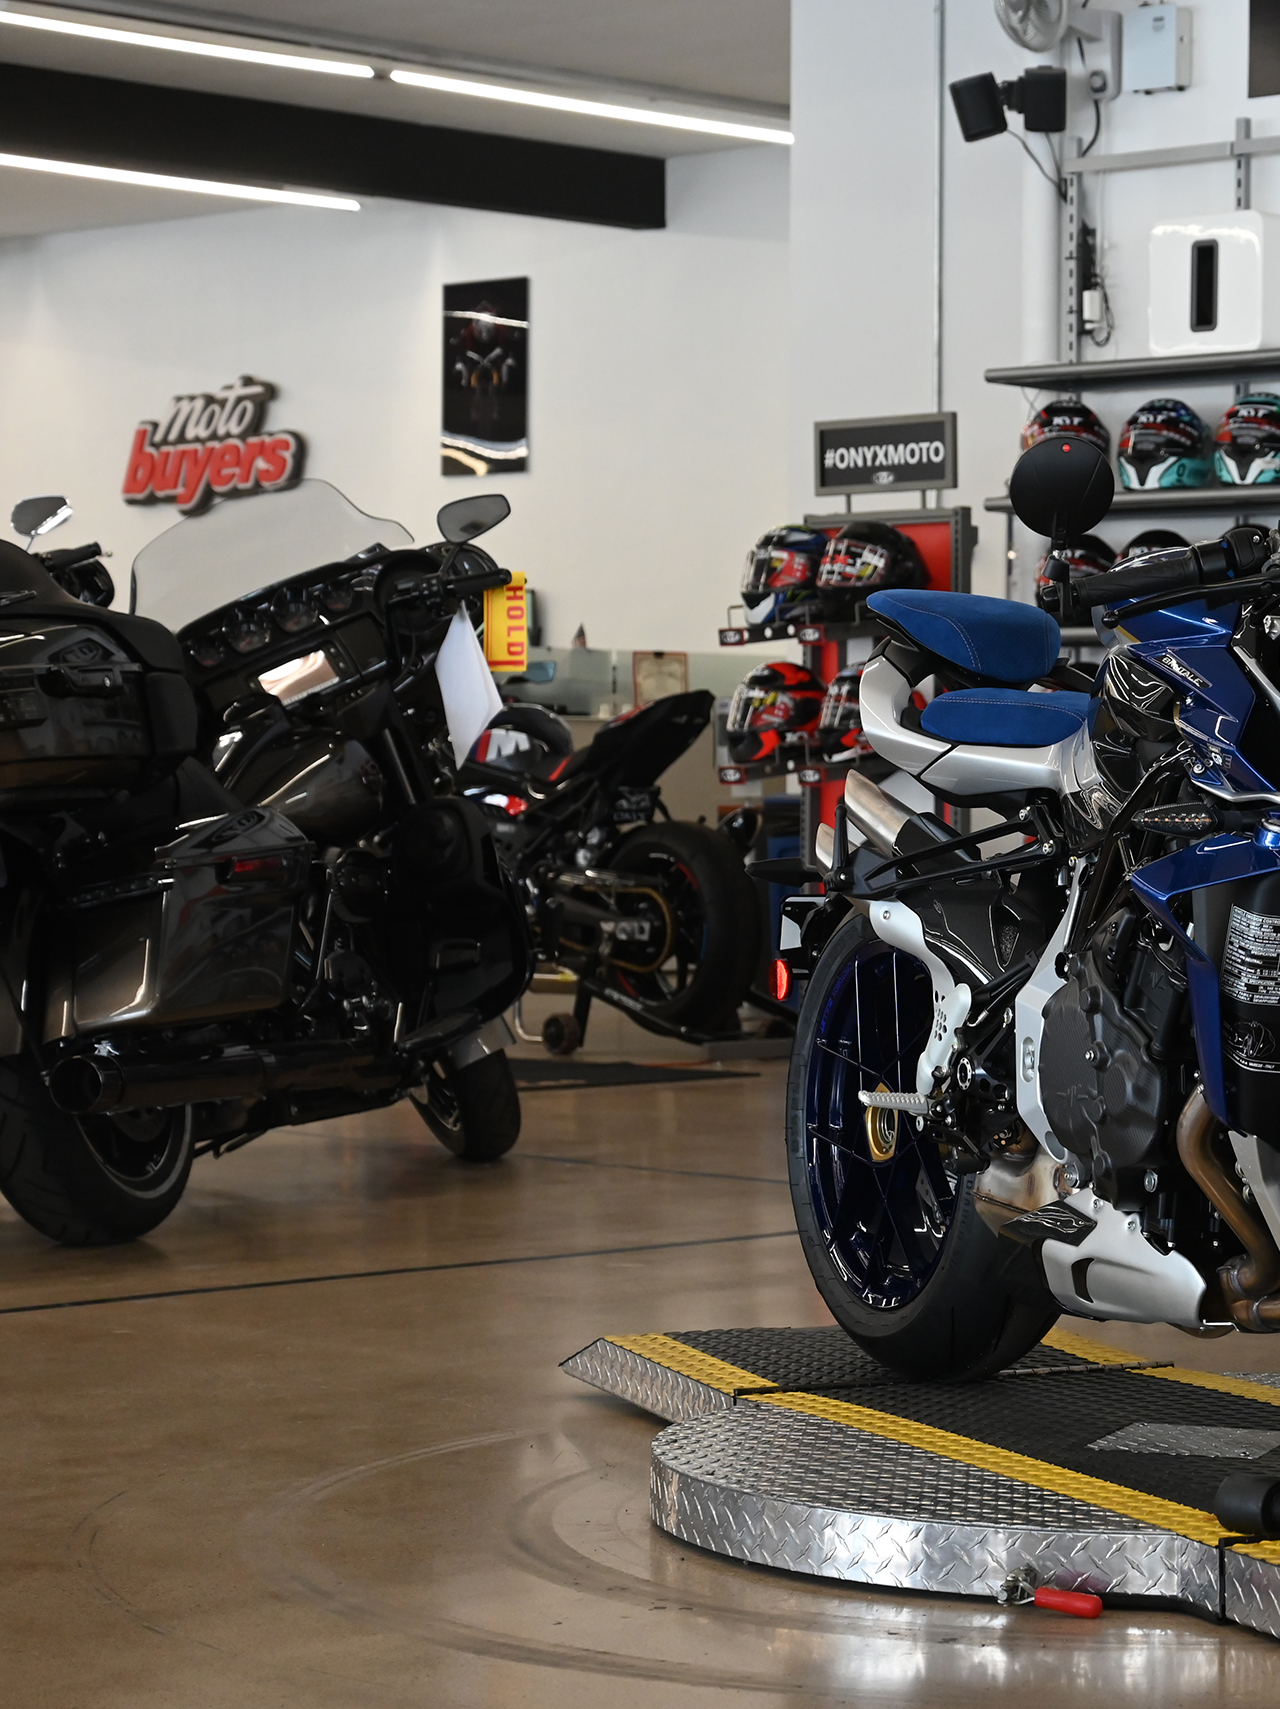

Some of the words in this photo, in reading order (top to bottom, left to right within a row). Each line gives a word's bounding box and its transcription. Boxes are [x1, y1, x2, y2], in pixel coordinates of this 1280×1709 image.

[121, 425, 293, 507] buyers
[823, 439, 946, 470] #ONYXMOTO
[505, 585, 526, 657] HOLD
[1161, 655, 1203, 688] BRUTALE
